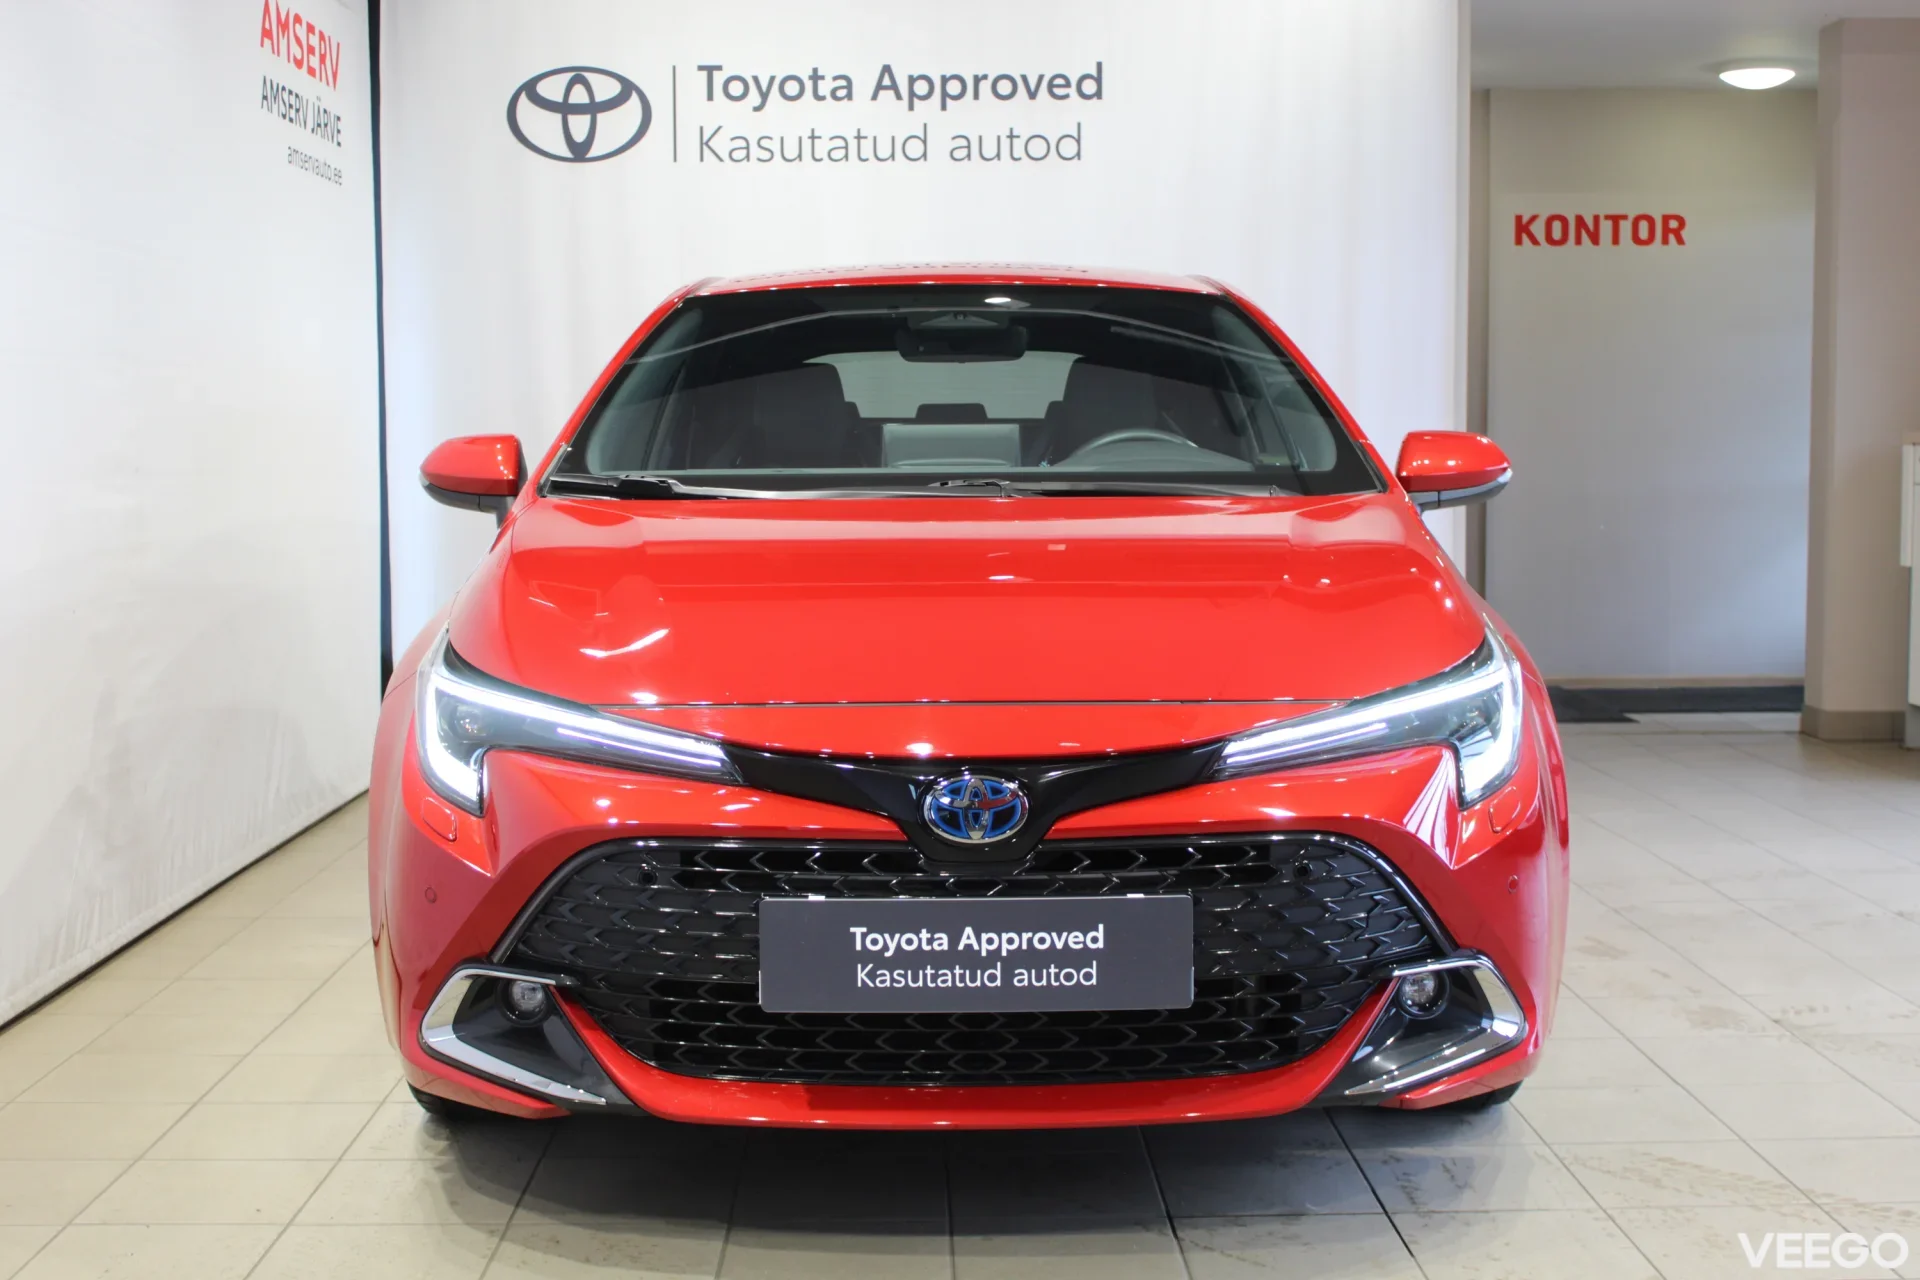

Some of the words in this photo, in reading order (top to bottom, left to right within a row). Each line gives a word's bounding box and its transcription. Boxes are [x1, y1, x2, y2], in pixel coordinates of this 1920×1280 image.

[260, 0, 341, 91] AMSERV
[697, 64, 853, 112] Toyota
[871, 61, 1103, 112] Approved
[261, 75, 309, 130] AMSERV
[311, 95, 342, 148] JÄRVE
[699, 122, 928, 163] Kasutatud
[949, 121, 1082, 162] autod
[287, 146, 342, 186] amservauto.ee
[1514, 213, 1687, 247] KONTOR
[849, 926, 949, 957] Toyota
[957, 923, 1104, 957] Approved
[857, 961, 1002, 988] Kasutatud
[1013, 960, 1097, 987] autod
